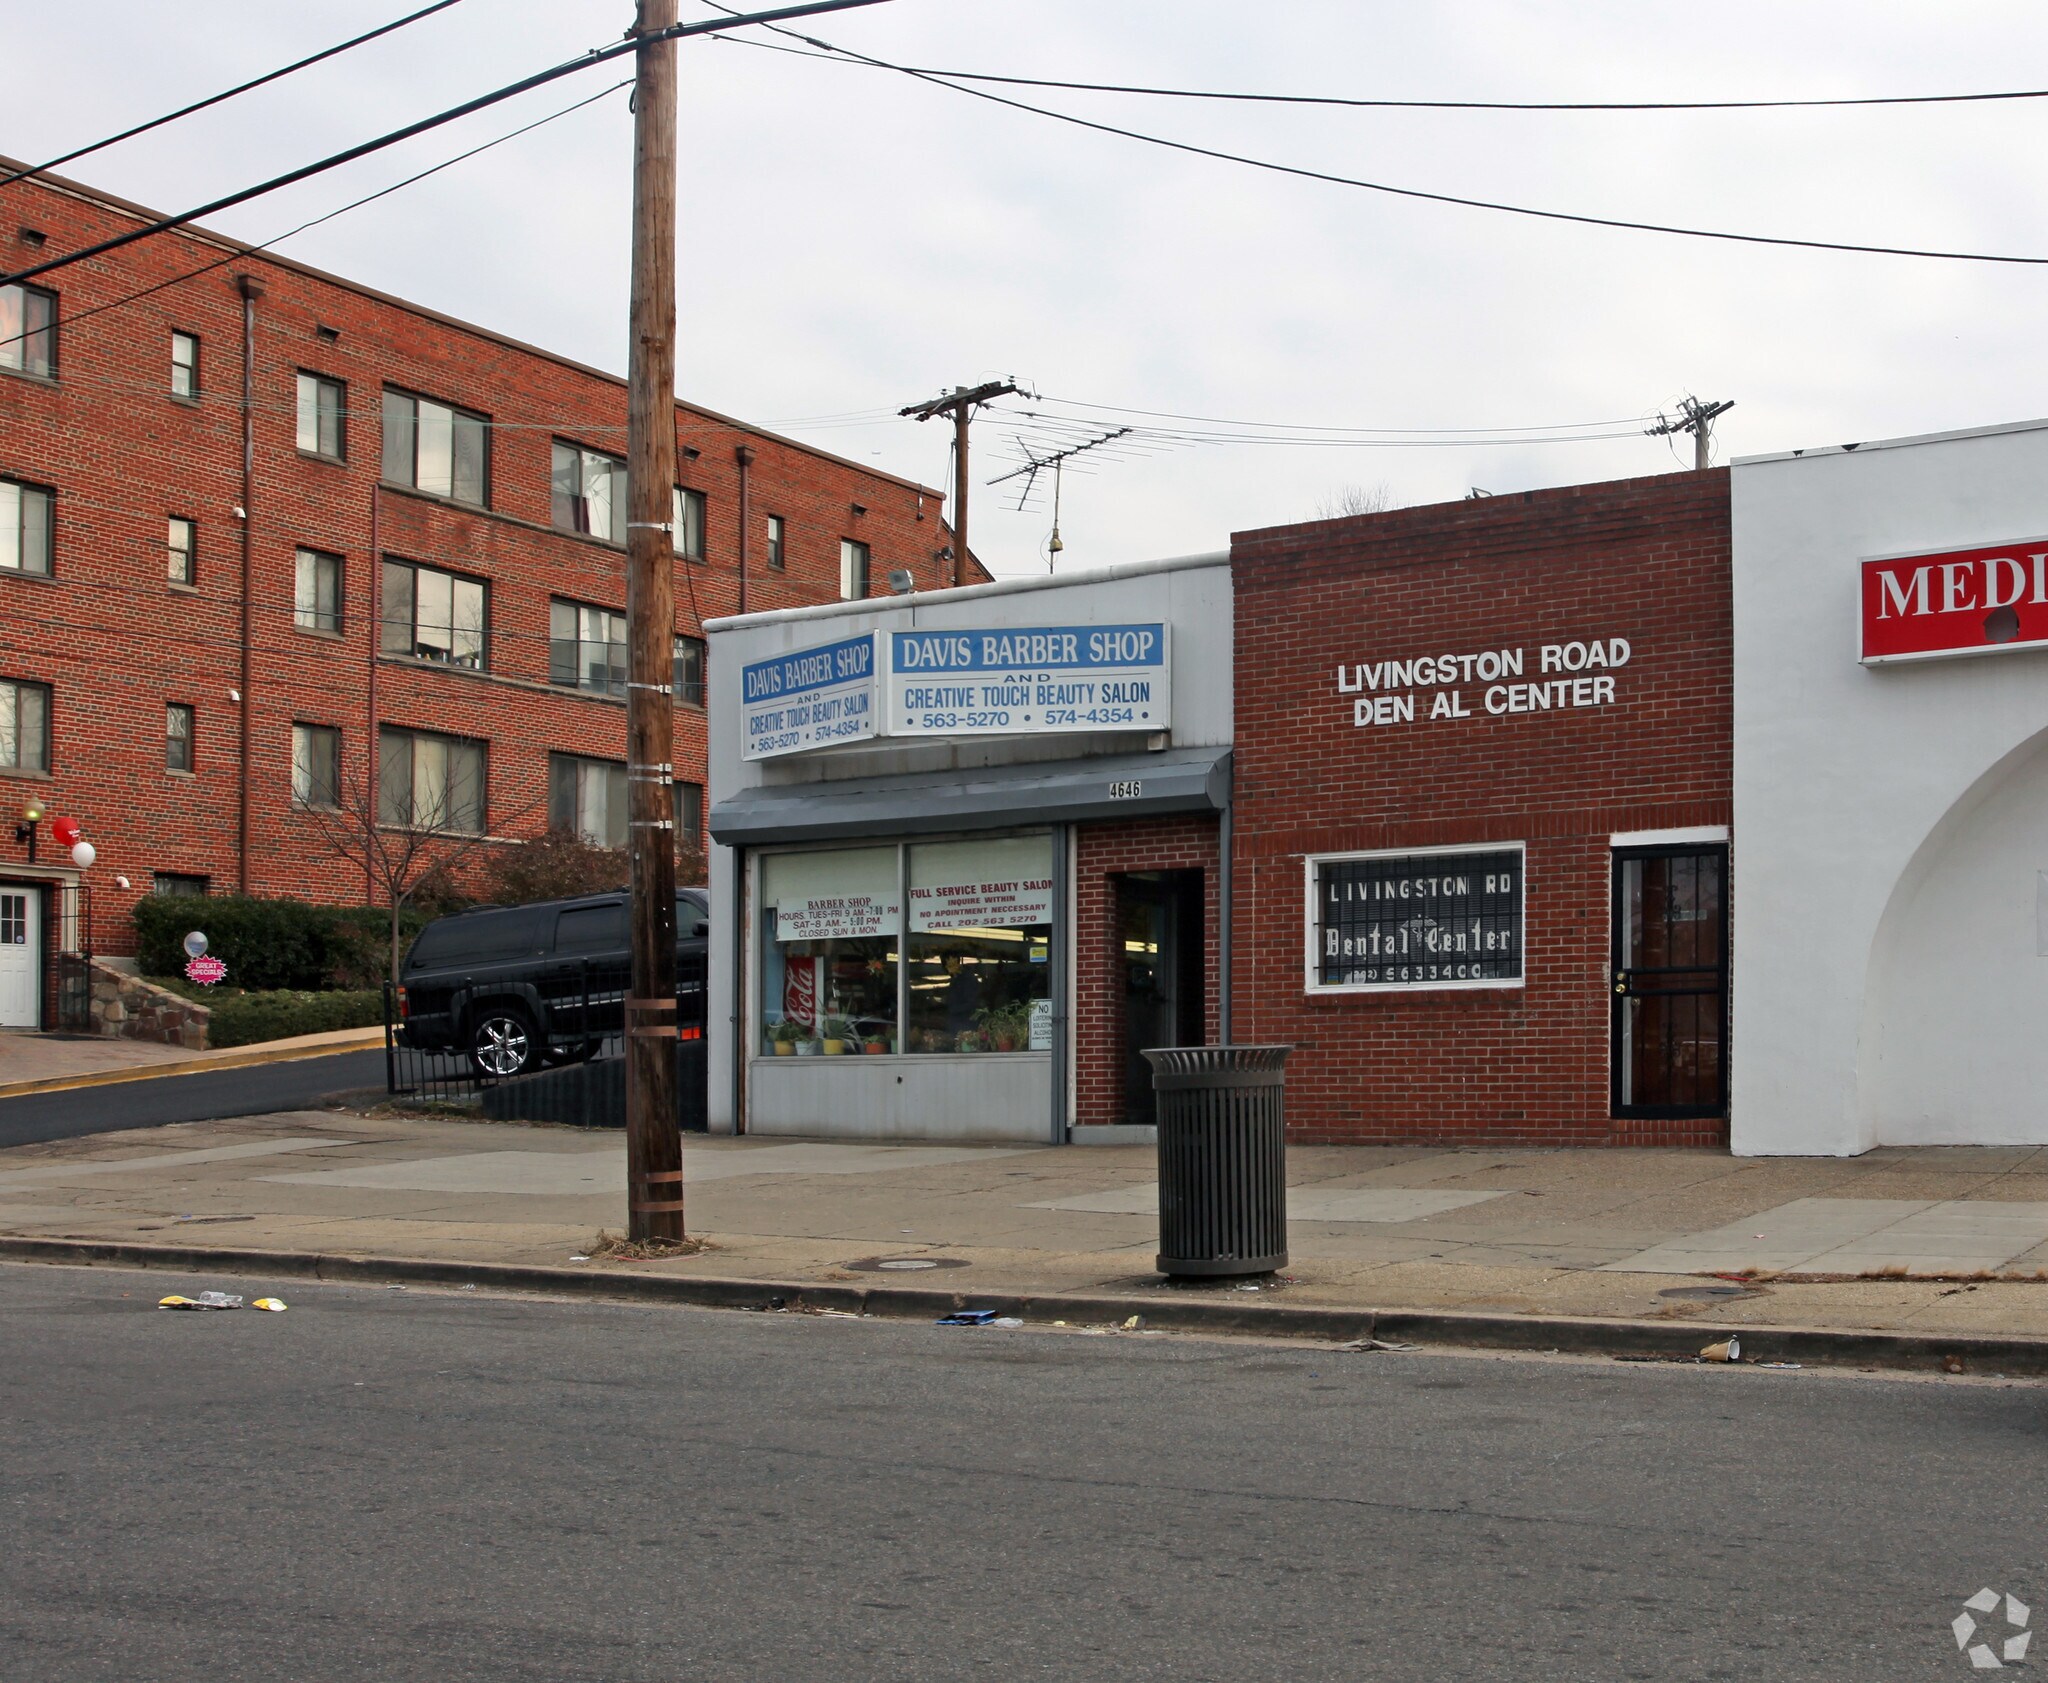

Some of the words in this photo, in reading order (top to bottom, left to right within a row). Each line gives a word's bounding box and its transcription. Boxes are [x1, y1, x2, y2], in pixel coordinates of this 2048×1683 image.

[1875, 553, 2048, 620] MEDI
[903, 637, 972, 667] DAVIS
[982, 634, 1078, 665] BARBER
[1089, 631, 1154, 662] SHOP
[747, 665, 781, 698] DAVIS
[785, 653, 833, 690] BARBER
[836, 643, 870, 678] SHOP
[1338, 648, 1523, 693] LIVINGSTON
[1540, 638, 1631, 673] ROAD
[1003, 673, 1051, 683] AND
[796, 693, 821, 705] AND
[905, 687, 975, 709] CREATIVE
[981, 686, 1030, 707] TOUCH
[1037, 683, 1095, 705] BEAUTY
[1101, 682, 1150, 704] SALON
[1484, 676, 1616, 714] CENTER
[750, 711, 784, 735] CREATIVE
[786, 705, 810, 728] TOUCH
[812, 699, 842, 723] BEAUTY
[844, 692, 869, 716] SALON
[922, 711, 1010, 728] 563-5270
[1045, 708, 1134, 724] 574-4354
[758, 731, 800, 752] 563-5270
[815, 719, 860, 741] 574-4354
[1110, 781, 1140, 797] 4646
[910, 889, 932, 899] FULL
[936, 885, 977, 897] SERVICE
[981, 882, 1019, 894] BEAUTY
[1023, 880, 1053, 891] SALON
[1331, 876, 1470, 902] LIVINGSTON
[1485, 874, 1511, 894] RD
[807, 899, 845, 910] BARBER
[848, 897, 872, 907] SHOP
[935, 907, 988, 917] APOINTMENT
[991, 903, 1047, 913] NECCESSARY
[948, 897, 980, 907] INQUIRE
[985, 895, 1016, 903] WITHIN
[958, 918, 979, 926] 202
[983, 917, 1005, 925] 563
[1010, 915, 1037, 923] 5270
[799, 928, 830, 938] CLOSED
[832, 927, 848, 936] SUN
[1326, 922, 1409, 958] Dental
[1427, 917, 1511, 955] Center
[786, 965, 813, 1027] Cola
[1038, 1004, 1049, 1014] NO
